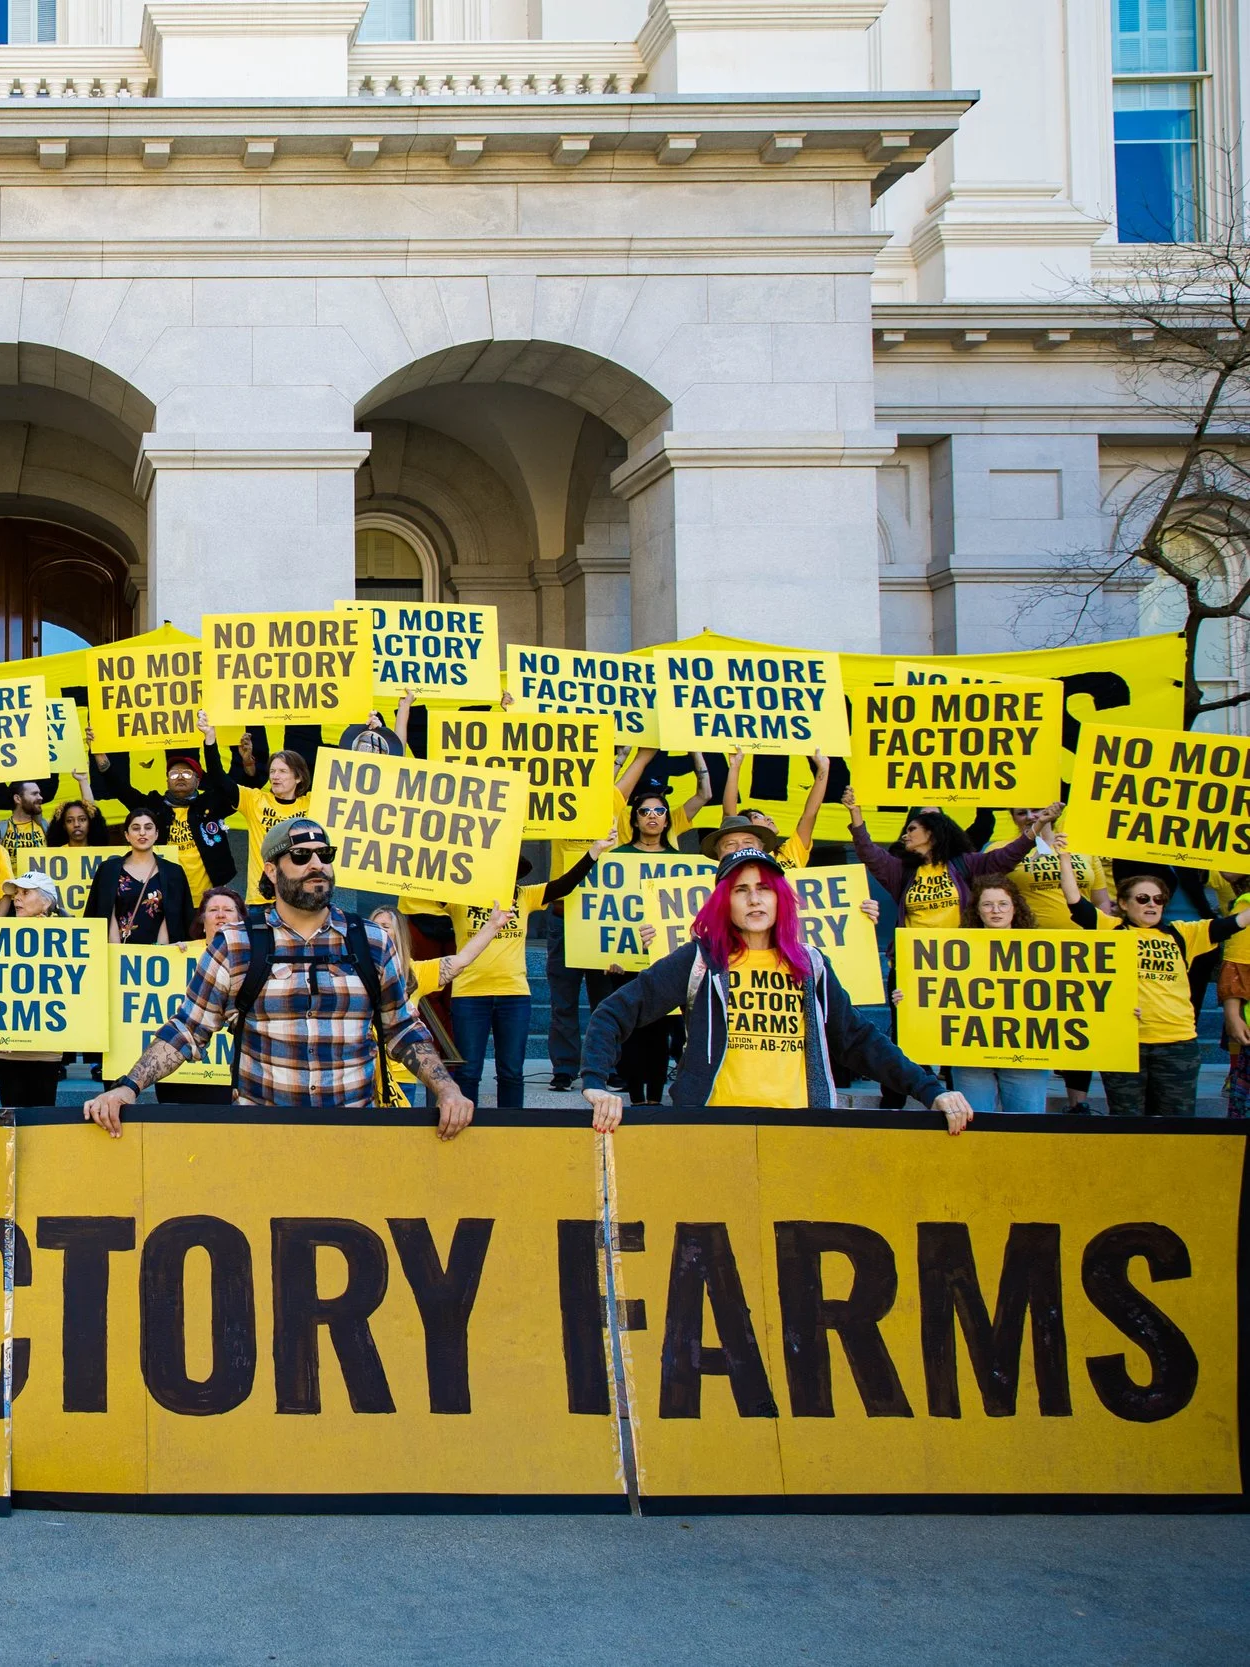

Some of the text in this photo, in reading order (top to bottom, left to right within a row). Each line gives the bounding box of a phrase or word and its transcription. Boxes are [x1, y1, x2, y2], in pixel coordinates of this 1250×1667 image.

[214, 620, 358, 649] NO MORE
[400, 609, 484, 634] MORE
[98, 656, 135, 681] NO
[217, 650, 355, 680] FACTORY
[519, 652, 560, 675] NO
[668, 658, 826, 683] NO MORE
[102, 680, 202, 710] FACTOR
[233, 682, 339, 710] FARMS
[522, 677, 656, 709] FACTORY
[674, 684, 824, 711] FACTORY
[867, 692, 1043, 723] NO MORE
[118, 710, 194, 737] FARM
[442, 721, 488, 750] NO
[502, 722, 598, 752] MORE
[693, 713, 811, 740] FARMS
[869, 726, 1039, 756] FACTORY
[1093, 735, 1250, 779] NO MO
[328, 759, 380, 795] NO
[395, 767, 511, 813] MORE
[887, 761, 1016, 790] FARMS
[1091, 771, 1250, 817] FACTOR
[326, 796, 502, 849] FACTORY
[29, 856, 68, 880] NO
[341, 835, 474, 885] FARMS
[1024, 860, 1086, 873] FACTRY
[1034, 870, 1085, 882] FARS
[908, 891, 952, 903] FARMS
[913, 939, 1116, 973] NO MORE
[1141, 958, 1174, 972] RMS
[120, 955, 169, 987] NO
[728, 991, 804, 1013] ACTORY
[918, 977, 1112, 1012] FACTORY
[941, 1015, 1089, 1051] FARMS
[557, 1220, 1200, 1423] FARMS
